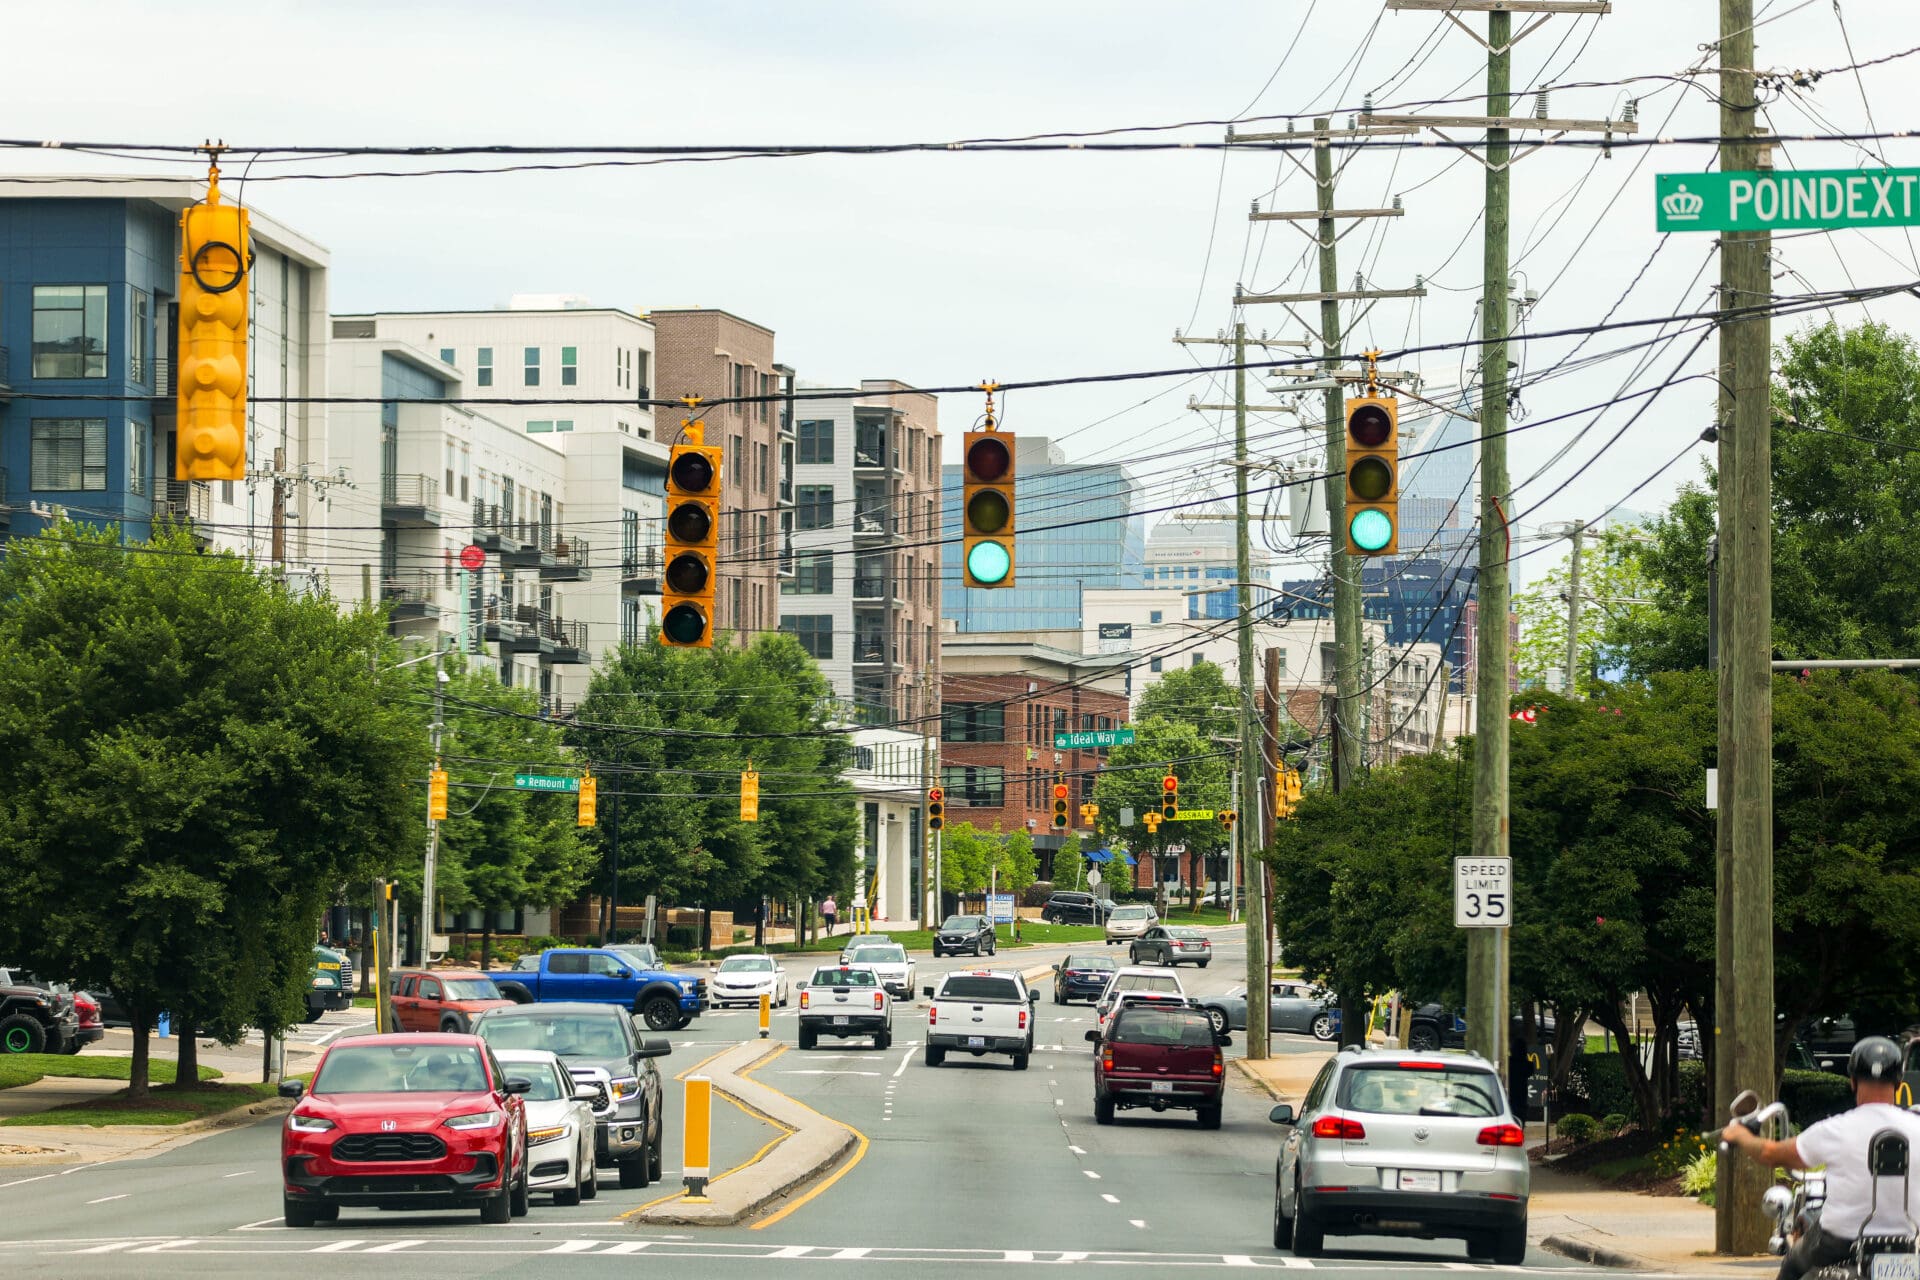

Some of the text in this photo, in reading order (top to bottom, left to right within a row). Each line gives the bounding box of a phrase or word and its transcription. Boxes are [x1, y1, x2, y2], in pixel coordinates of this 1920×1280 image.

[1729, 175, 1920, 222] POINDEXT
[1070, 732, 1094, 745] Ideal
[1096, 732, 1115, 745] Way
[528, 777, 565, 789] Remount
[1461, 865, 1506, 876] SPEED
[1465, 879, 1501, 890] LIMIT
[1465, 893, 1505, 918] 35
